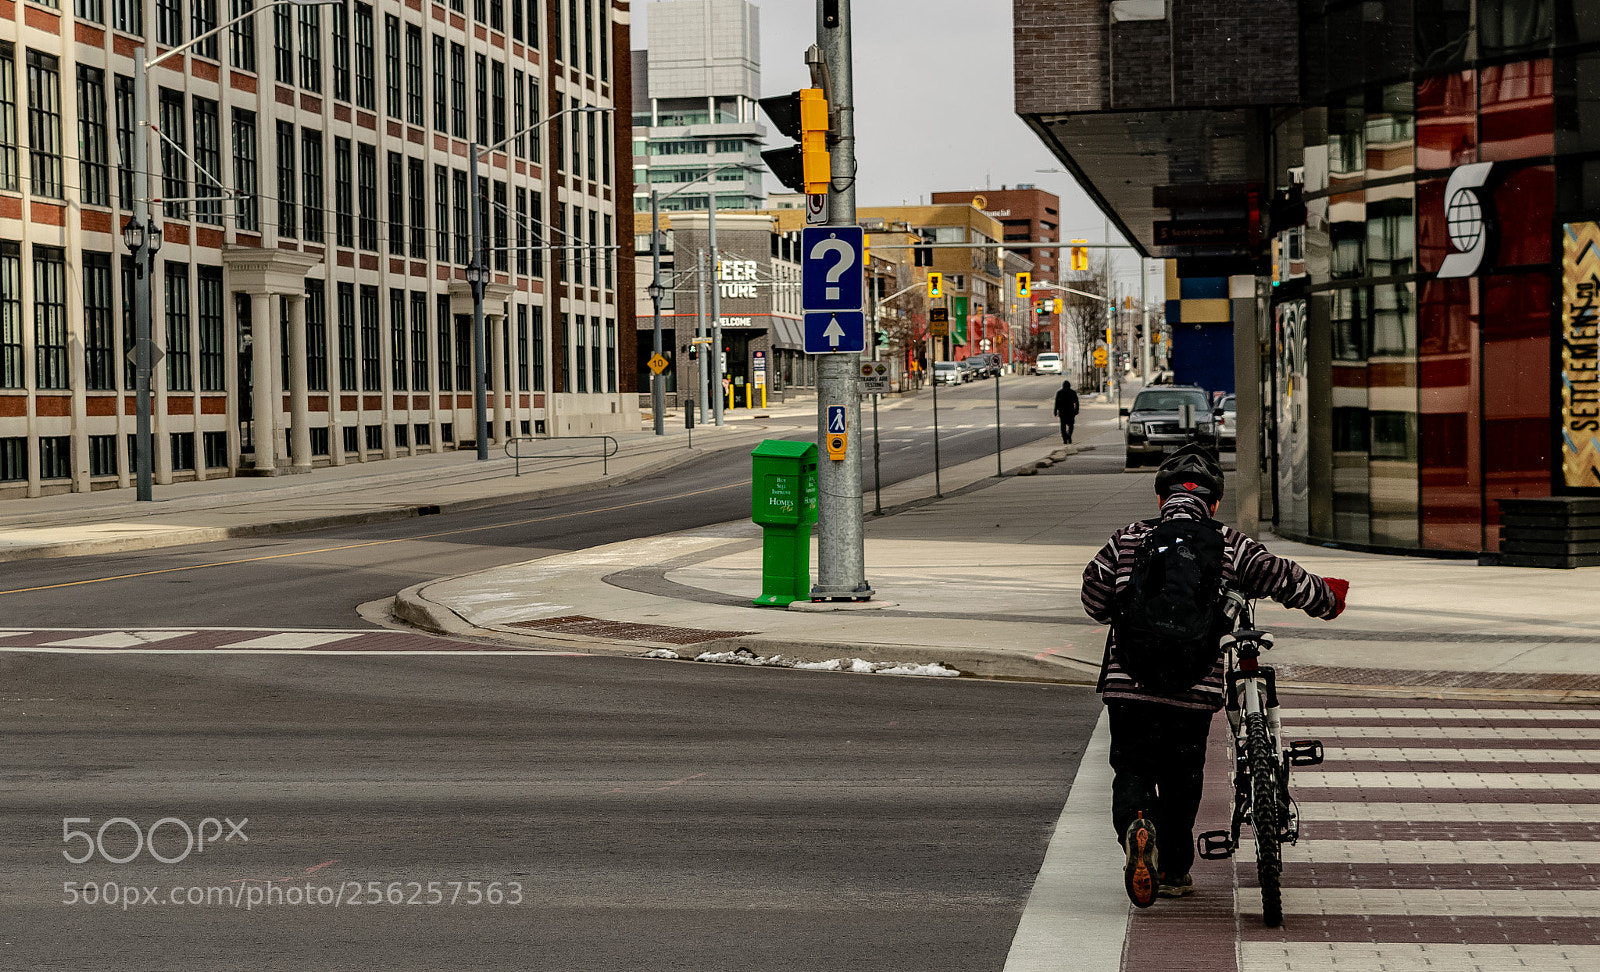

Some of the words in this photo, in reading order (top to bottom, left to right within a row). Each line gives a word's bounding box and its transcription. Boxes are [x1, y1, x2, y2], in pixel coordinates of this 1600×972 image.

[1171, 226, 1225, 238] Scotiabank
[717, 260, 758, 281] EER
[653, 359, 664, 368] 10
[1569, 302, 1600, 432] SETTLEMENT
